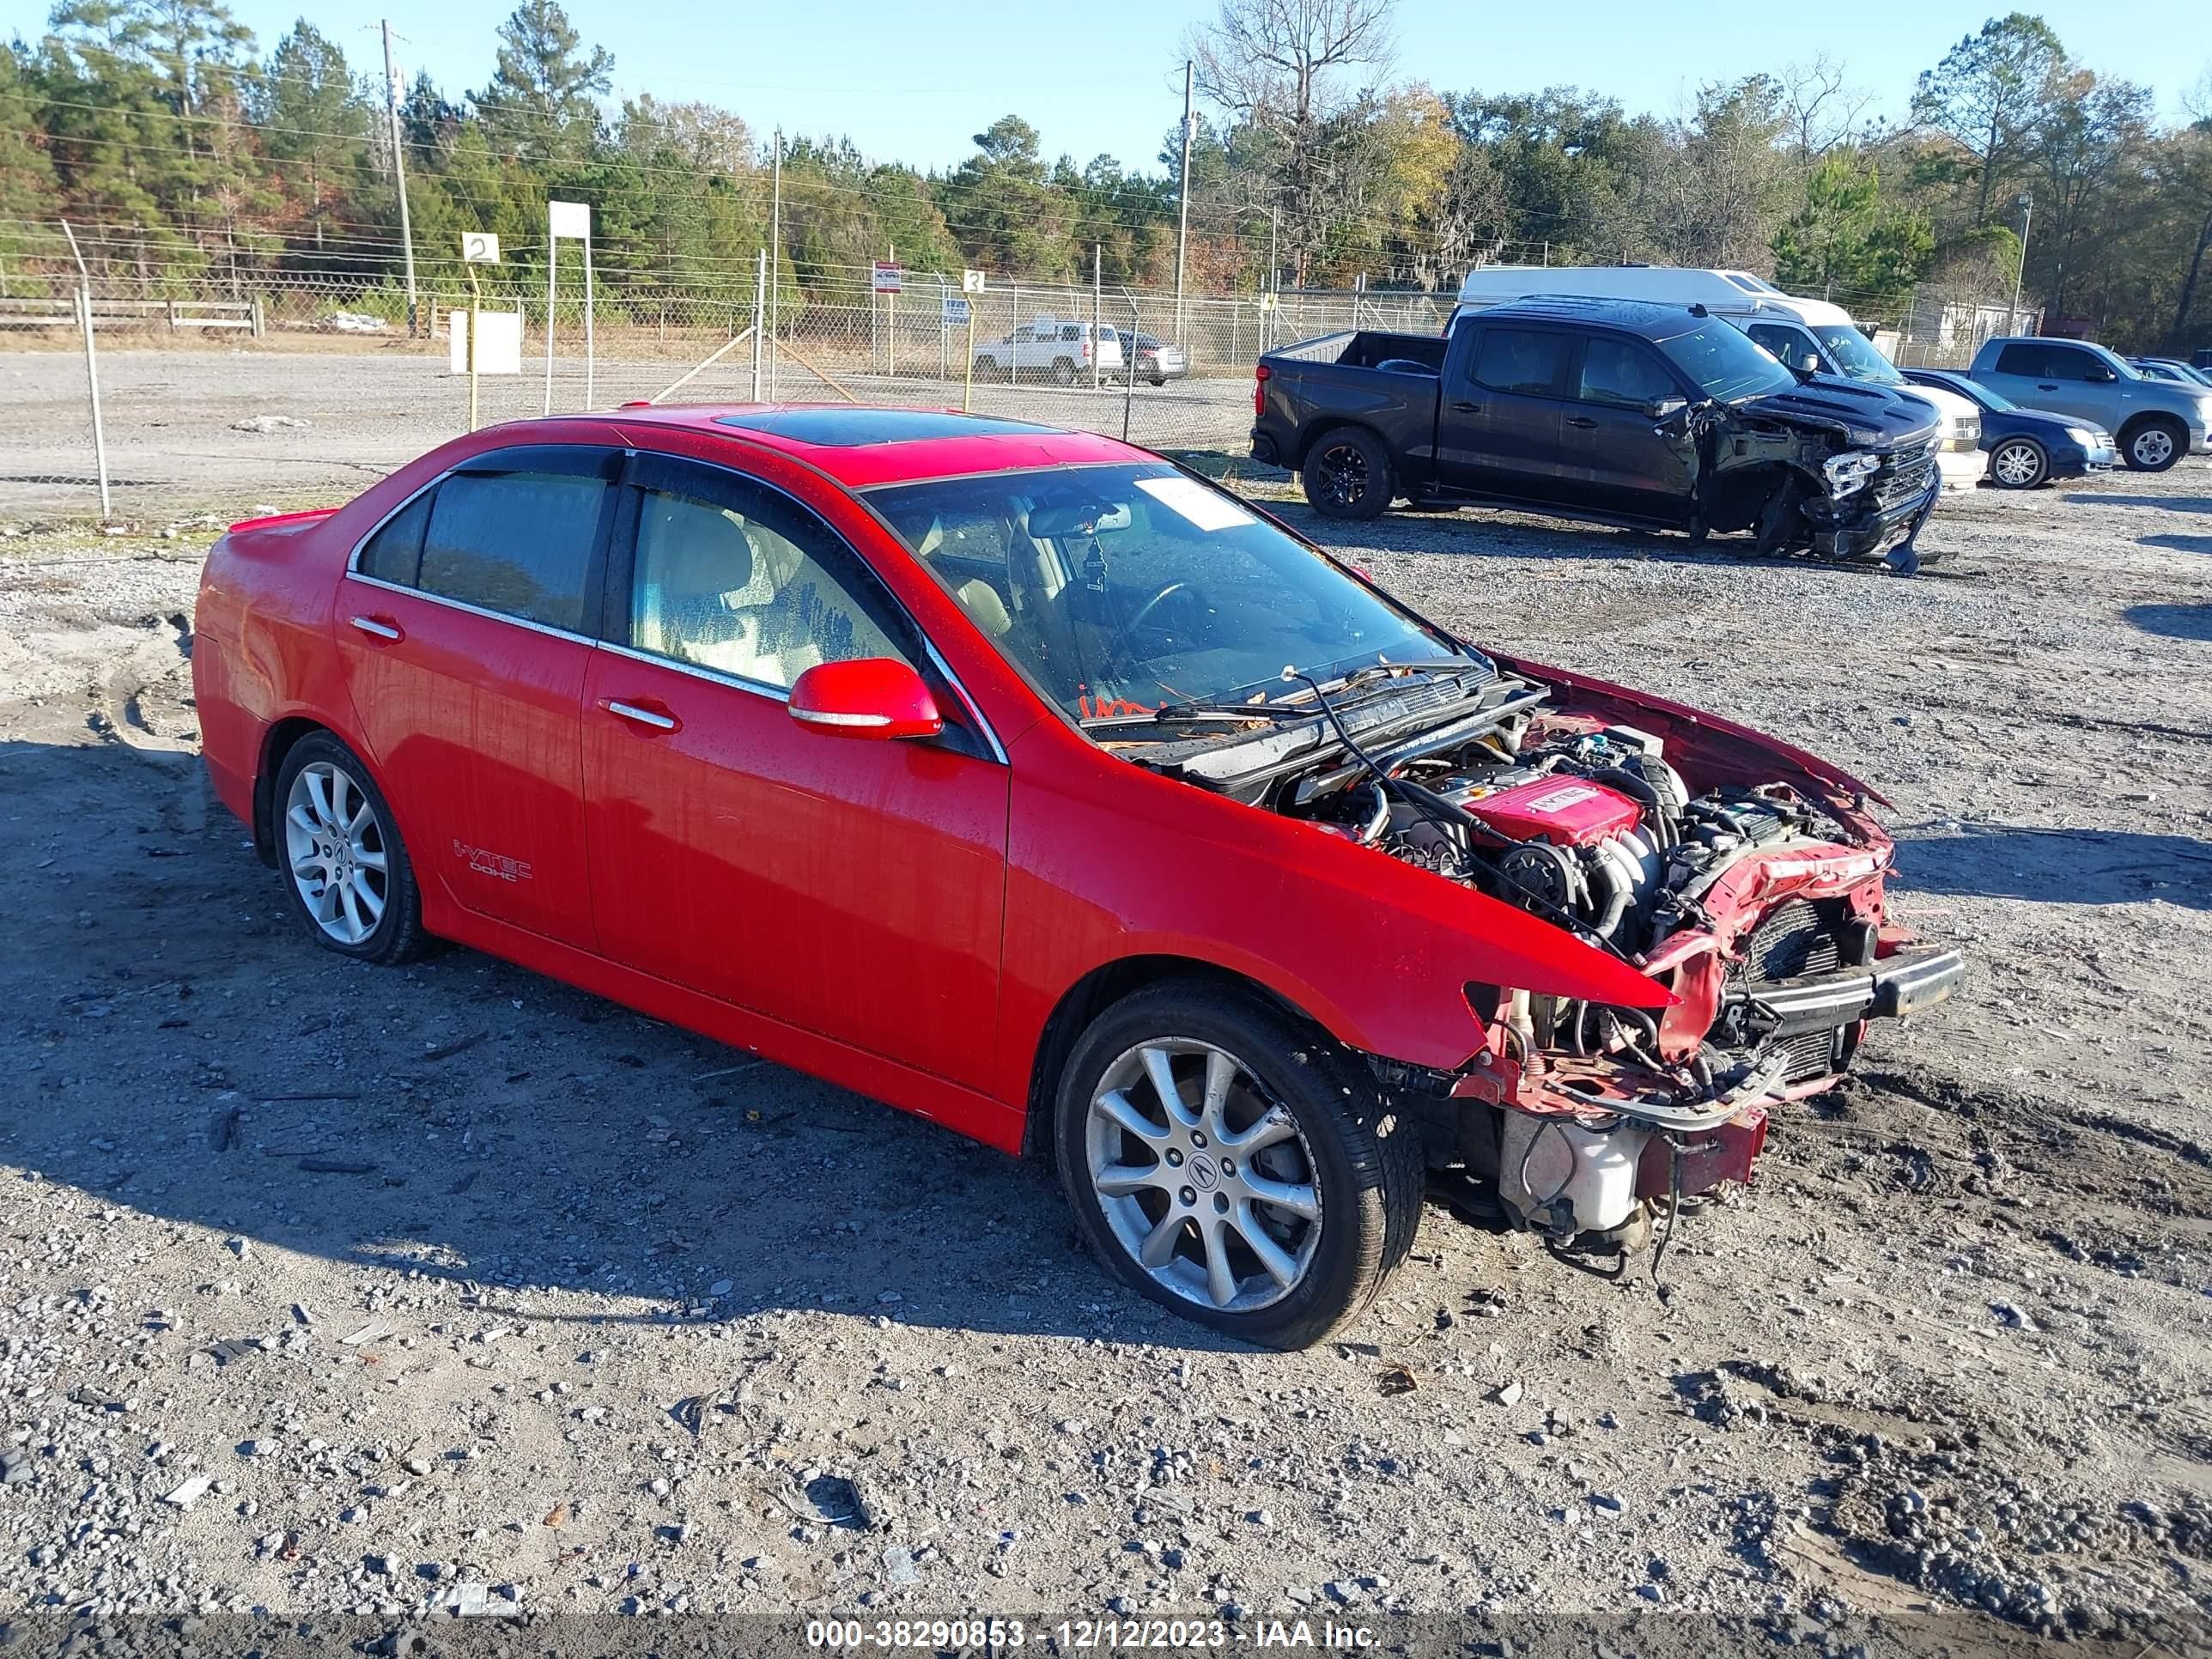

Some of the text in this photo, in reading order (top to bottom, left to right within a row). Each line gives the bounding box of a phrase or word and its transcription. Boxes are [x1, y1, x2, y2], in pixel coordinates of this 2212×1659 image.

[470, 238, 493, 261] 2
[968, 271, 981, 292] 3
[469, 861, 517, 883] DOHC
